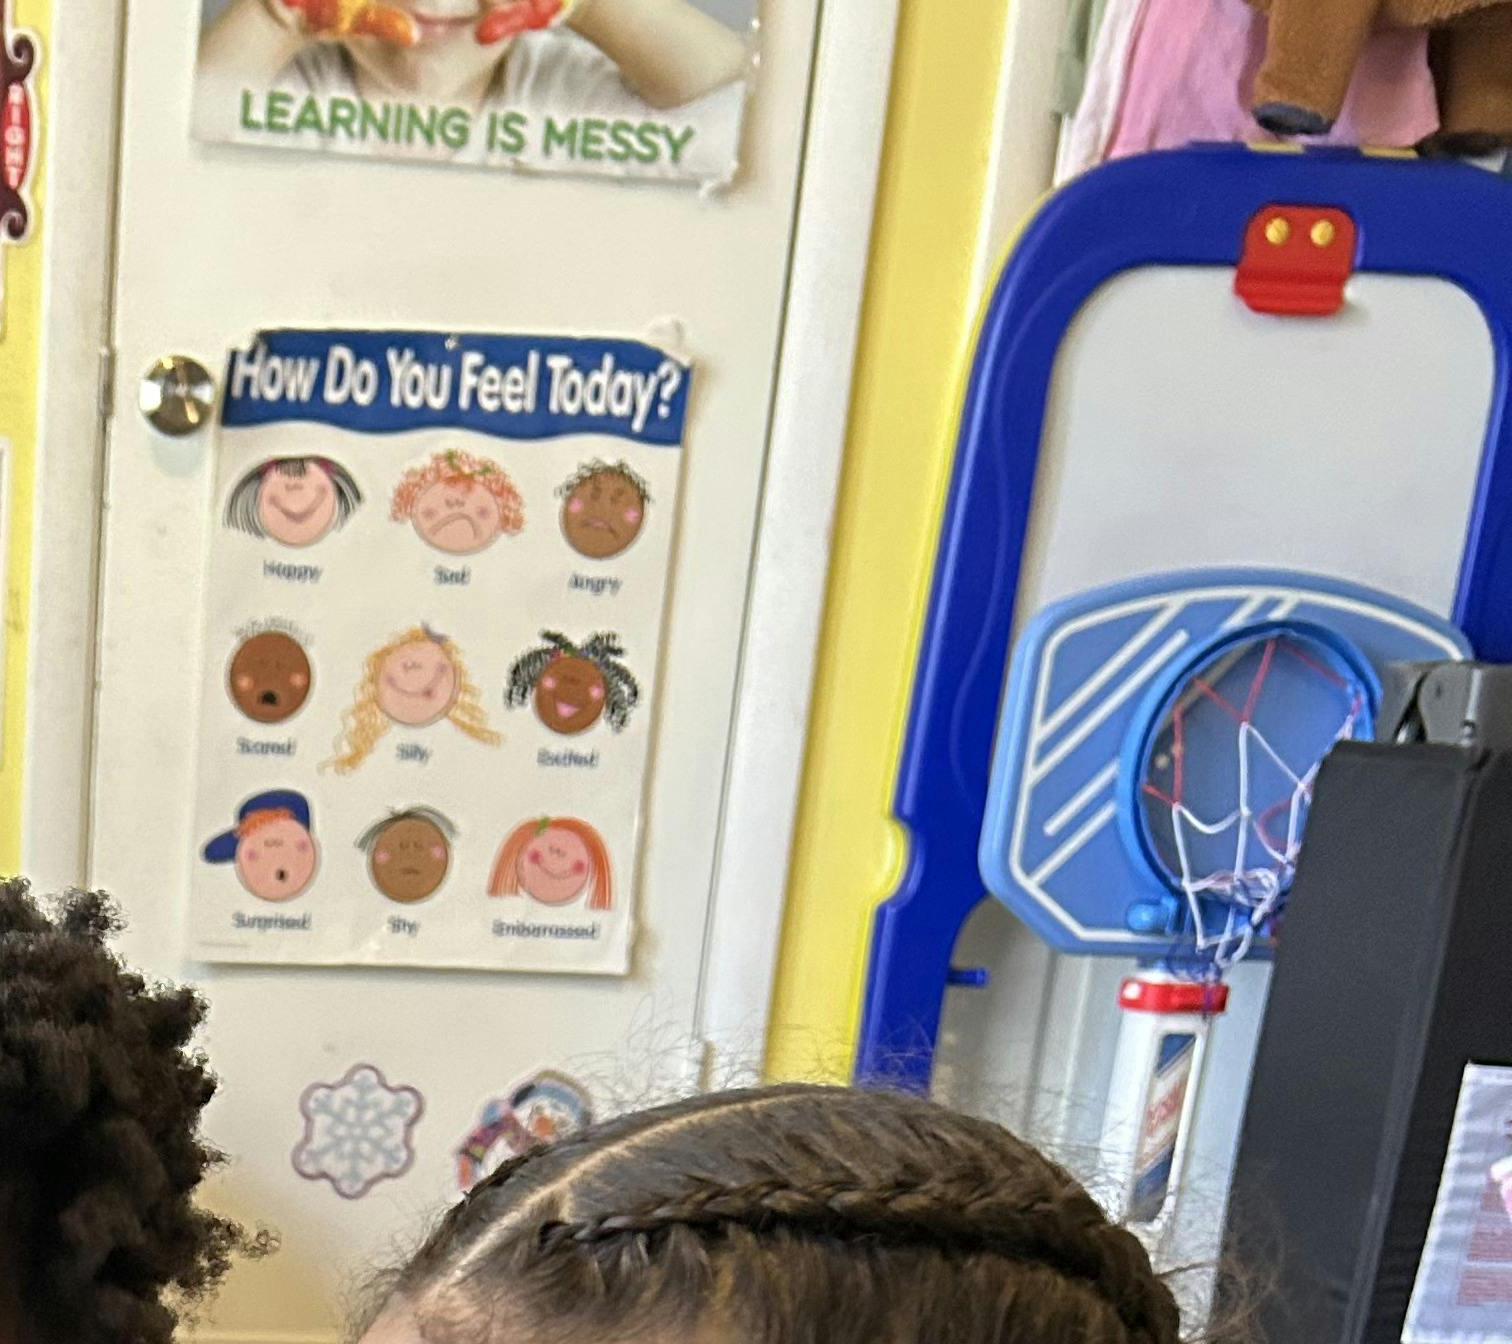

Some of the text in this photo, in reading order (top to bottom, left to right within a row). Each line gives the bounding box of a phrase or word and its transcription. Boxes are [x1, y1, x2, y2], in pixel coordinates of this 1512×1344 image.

[238, 88, 695, 164] LEARNING IS MESSY
[232, 345, 680, 433] How Do You Feel Today?
